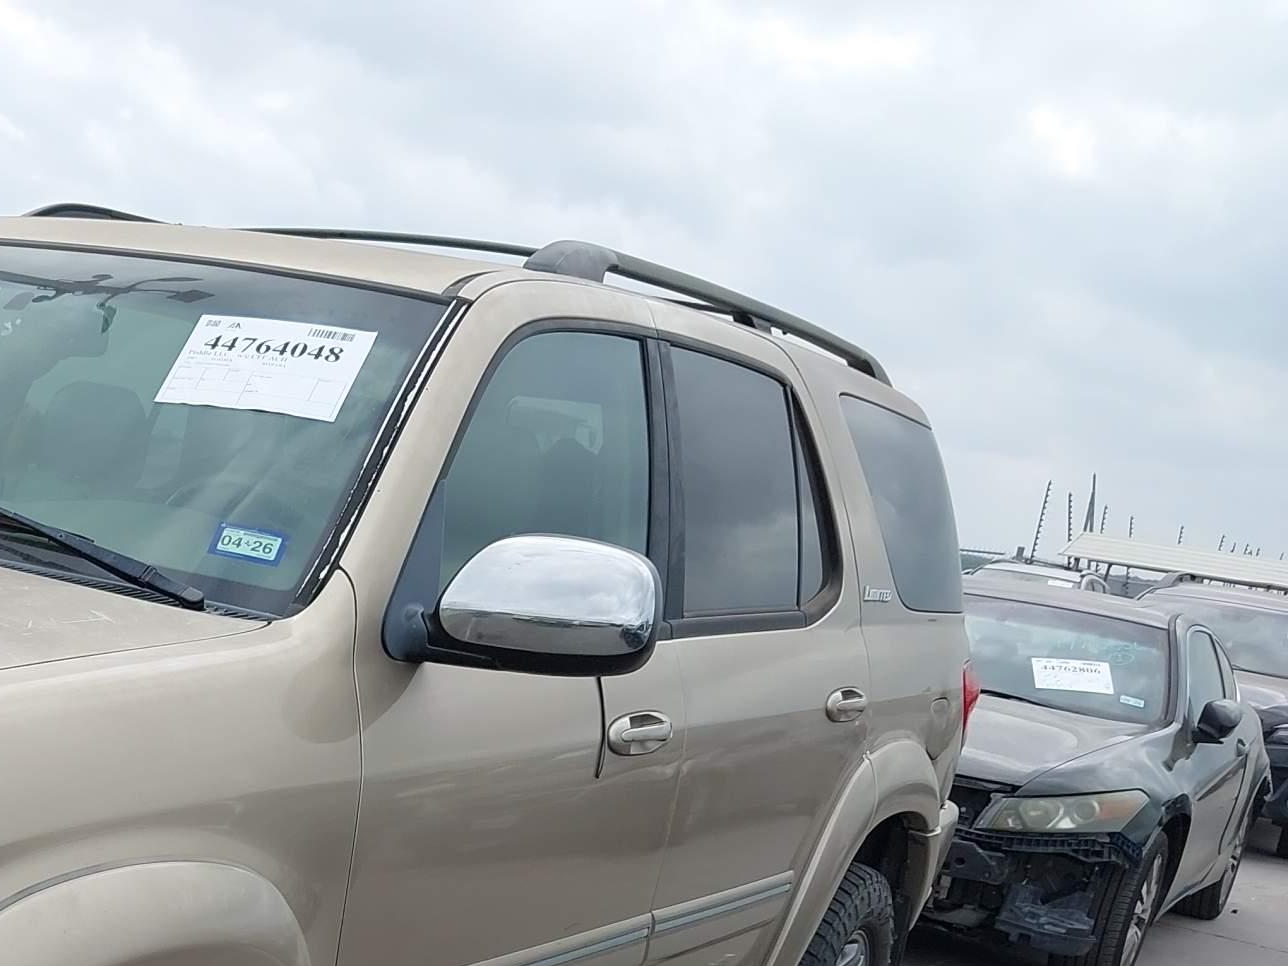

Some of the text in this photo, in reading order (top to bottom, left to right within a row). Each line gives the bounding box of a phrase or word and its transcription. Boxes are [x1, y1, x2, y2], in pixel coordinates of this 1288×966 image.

[203, 334, 344, 363] 44764048
[220, 535, 243, 549] 04
[250, 540, 274, 554] 26
